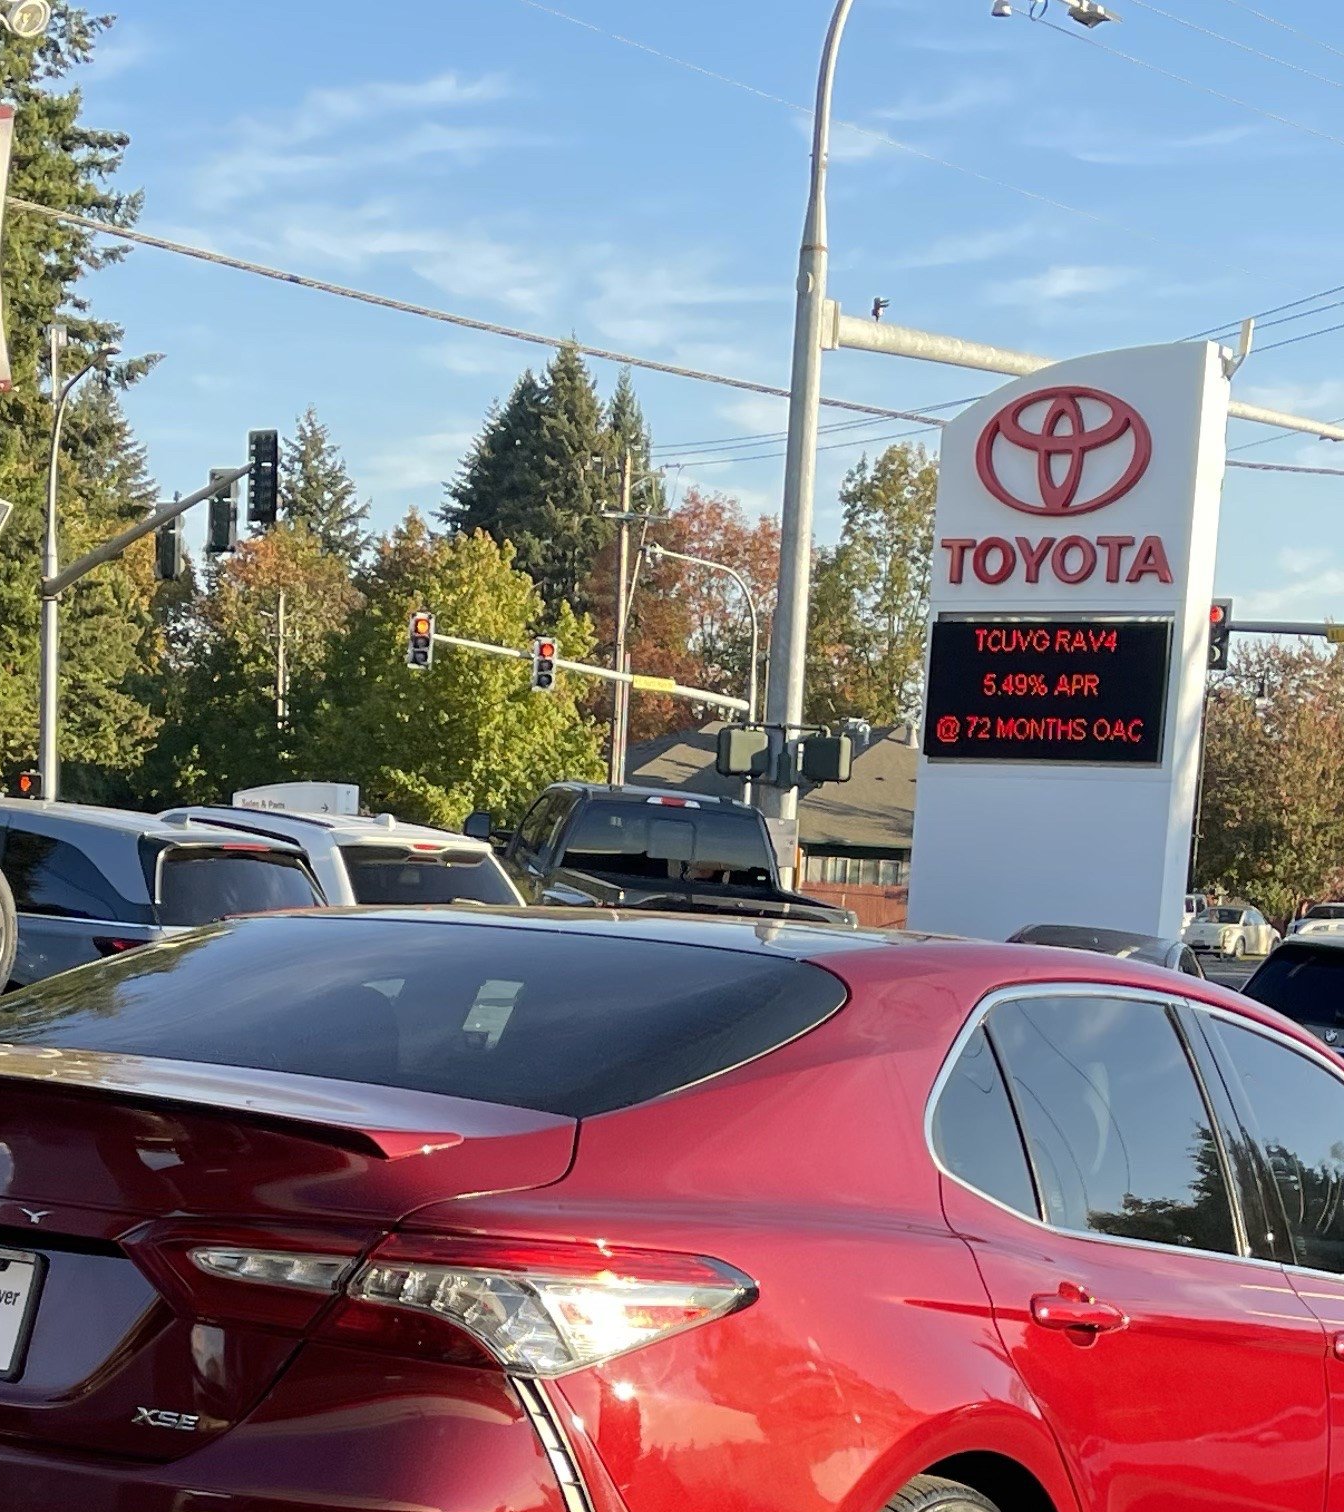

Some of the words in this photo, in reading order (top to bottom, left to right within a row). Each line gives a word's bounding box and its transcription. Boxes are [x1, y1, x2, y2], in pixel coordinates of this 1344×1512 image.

[941, 534, 1174, 585] TOYOTA
[1055, 628, 1119, 653] RAV4
[982, 673, 1049, 697] 5.49%
[1053, 673, 1100, 698] APR
[936, 715, 960, 743] @
[966, 715, 992, 740] 72
[996, 716, 1088, 741] MONTHS
[1092, 718, 1145, 744] OAC
[130, 1405, 200, 1431] XSE
